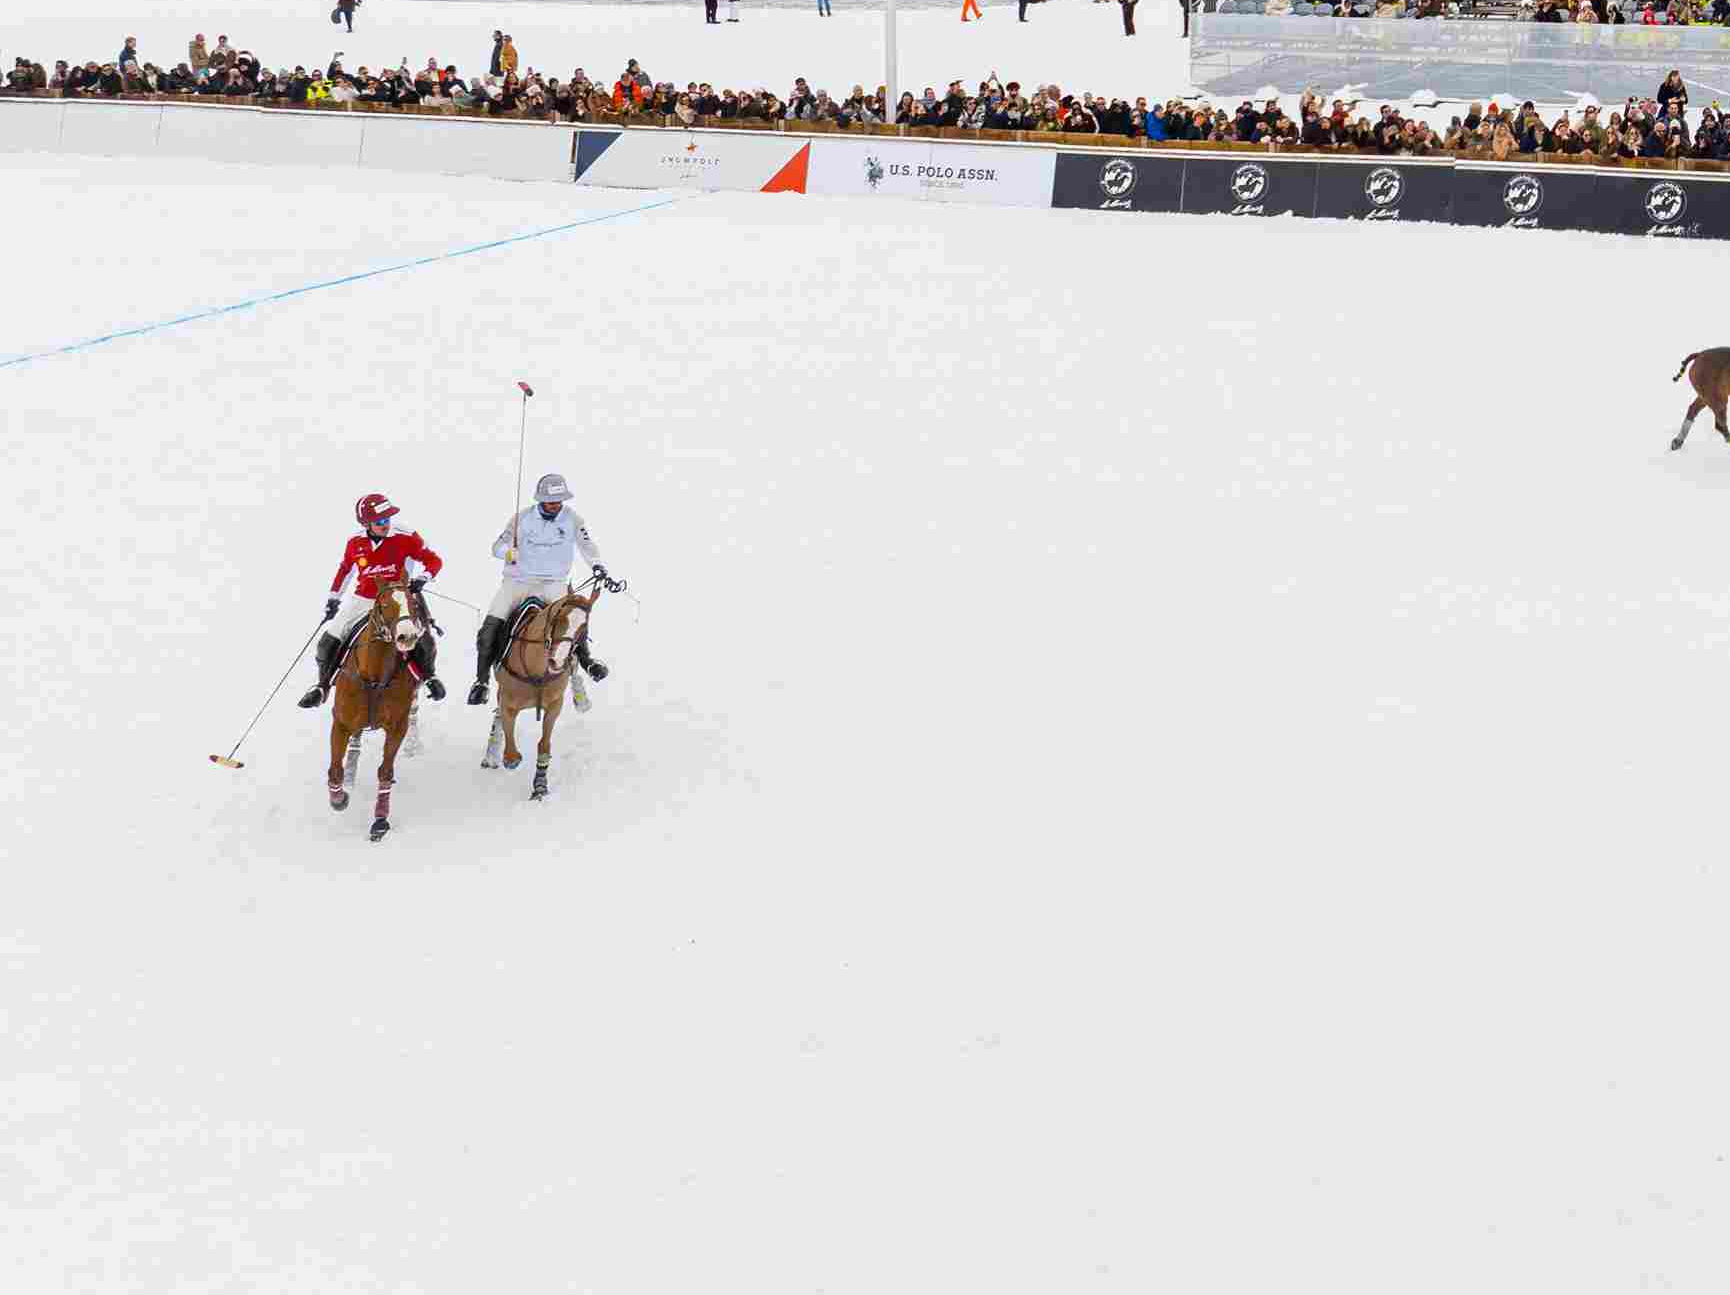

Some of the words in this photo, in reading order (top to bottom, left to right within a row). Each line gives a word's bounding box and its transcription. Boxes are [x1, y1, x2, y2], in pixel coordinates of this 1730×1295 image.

[889, 164, 913, 176] U.S.
[917, 166, 954, 178] POLO
[957, 168, 999, 181] ASSN.
